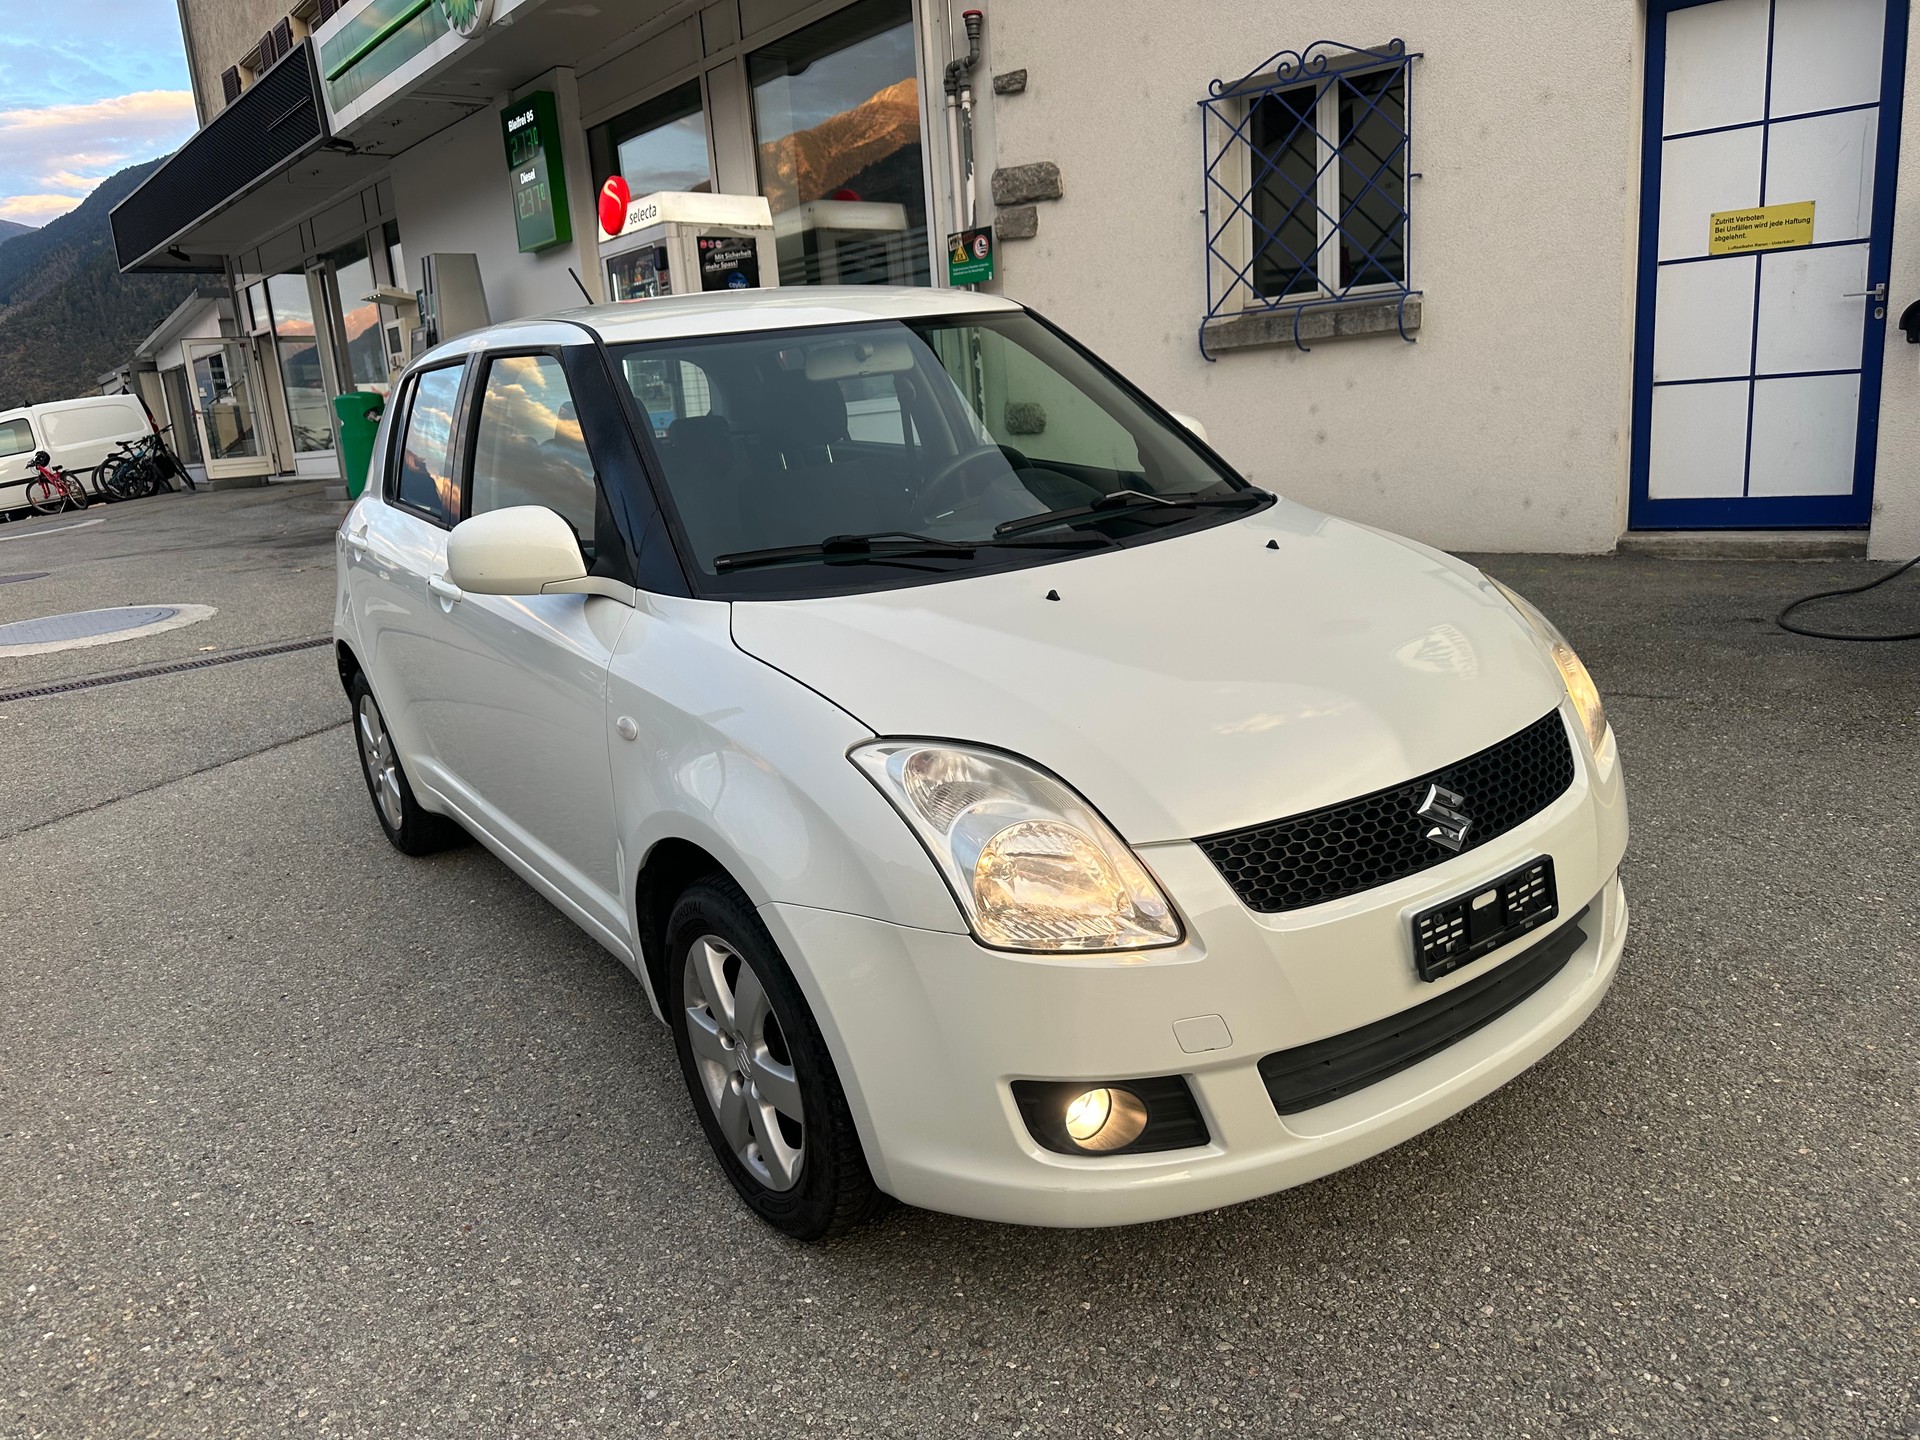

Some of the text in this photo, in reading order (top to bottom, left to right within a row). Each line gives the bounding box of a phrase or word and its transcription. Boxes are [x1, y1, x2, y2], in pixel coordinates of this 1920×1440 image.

[508, 109, 534, 133] Bleifrei 95
[520, 167, 536, 185] Diesel
[629, 204, 657, 225] selecta
[1714, 214, 1765, 225] Zutritt Verboten
[1714, 217, 1811, 234] Bei Unfällen wird jede Haftung
[1714, 232, 1747, 242] abgelehnt.
[714, 250, 751, 261] Mit Sicherheit
[706, 262, 720, 270] mehr
